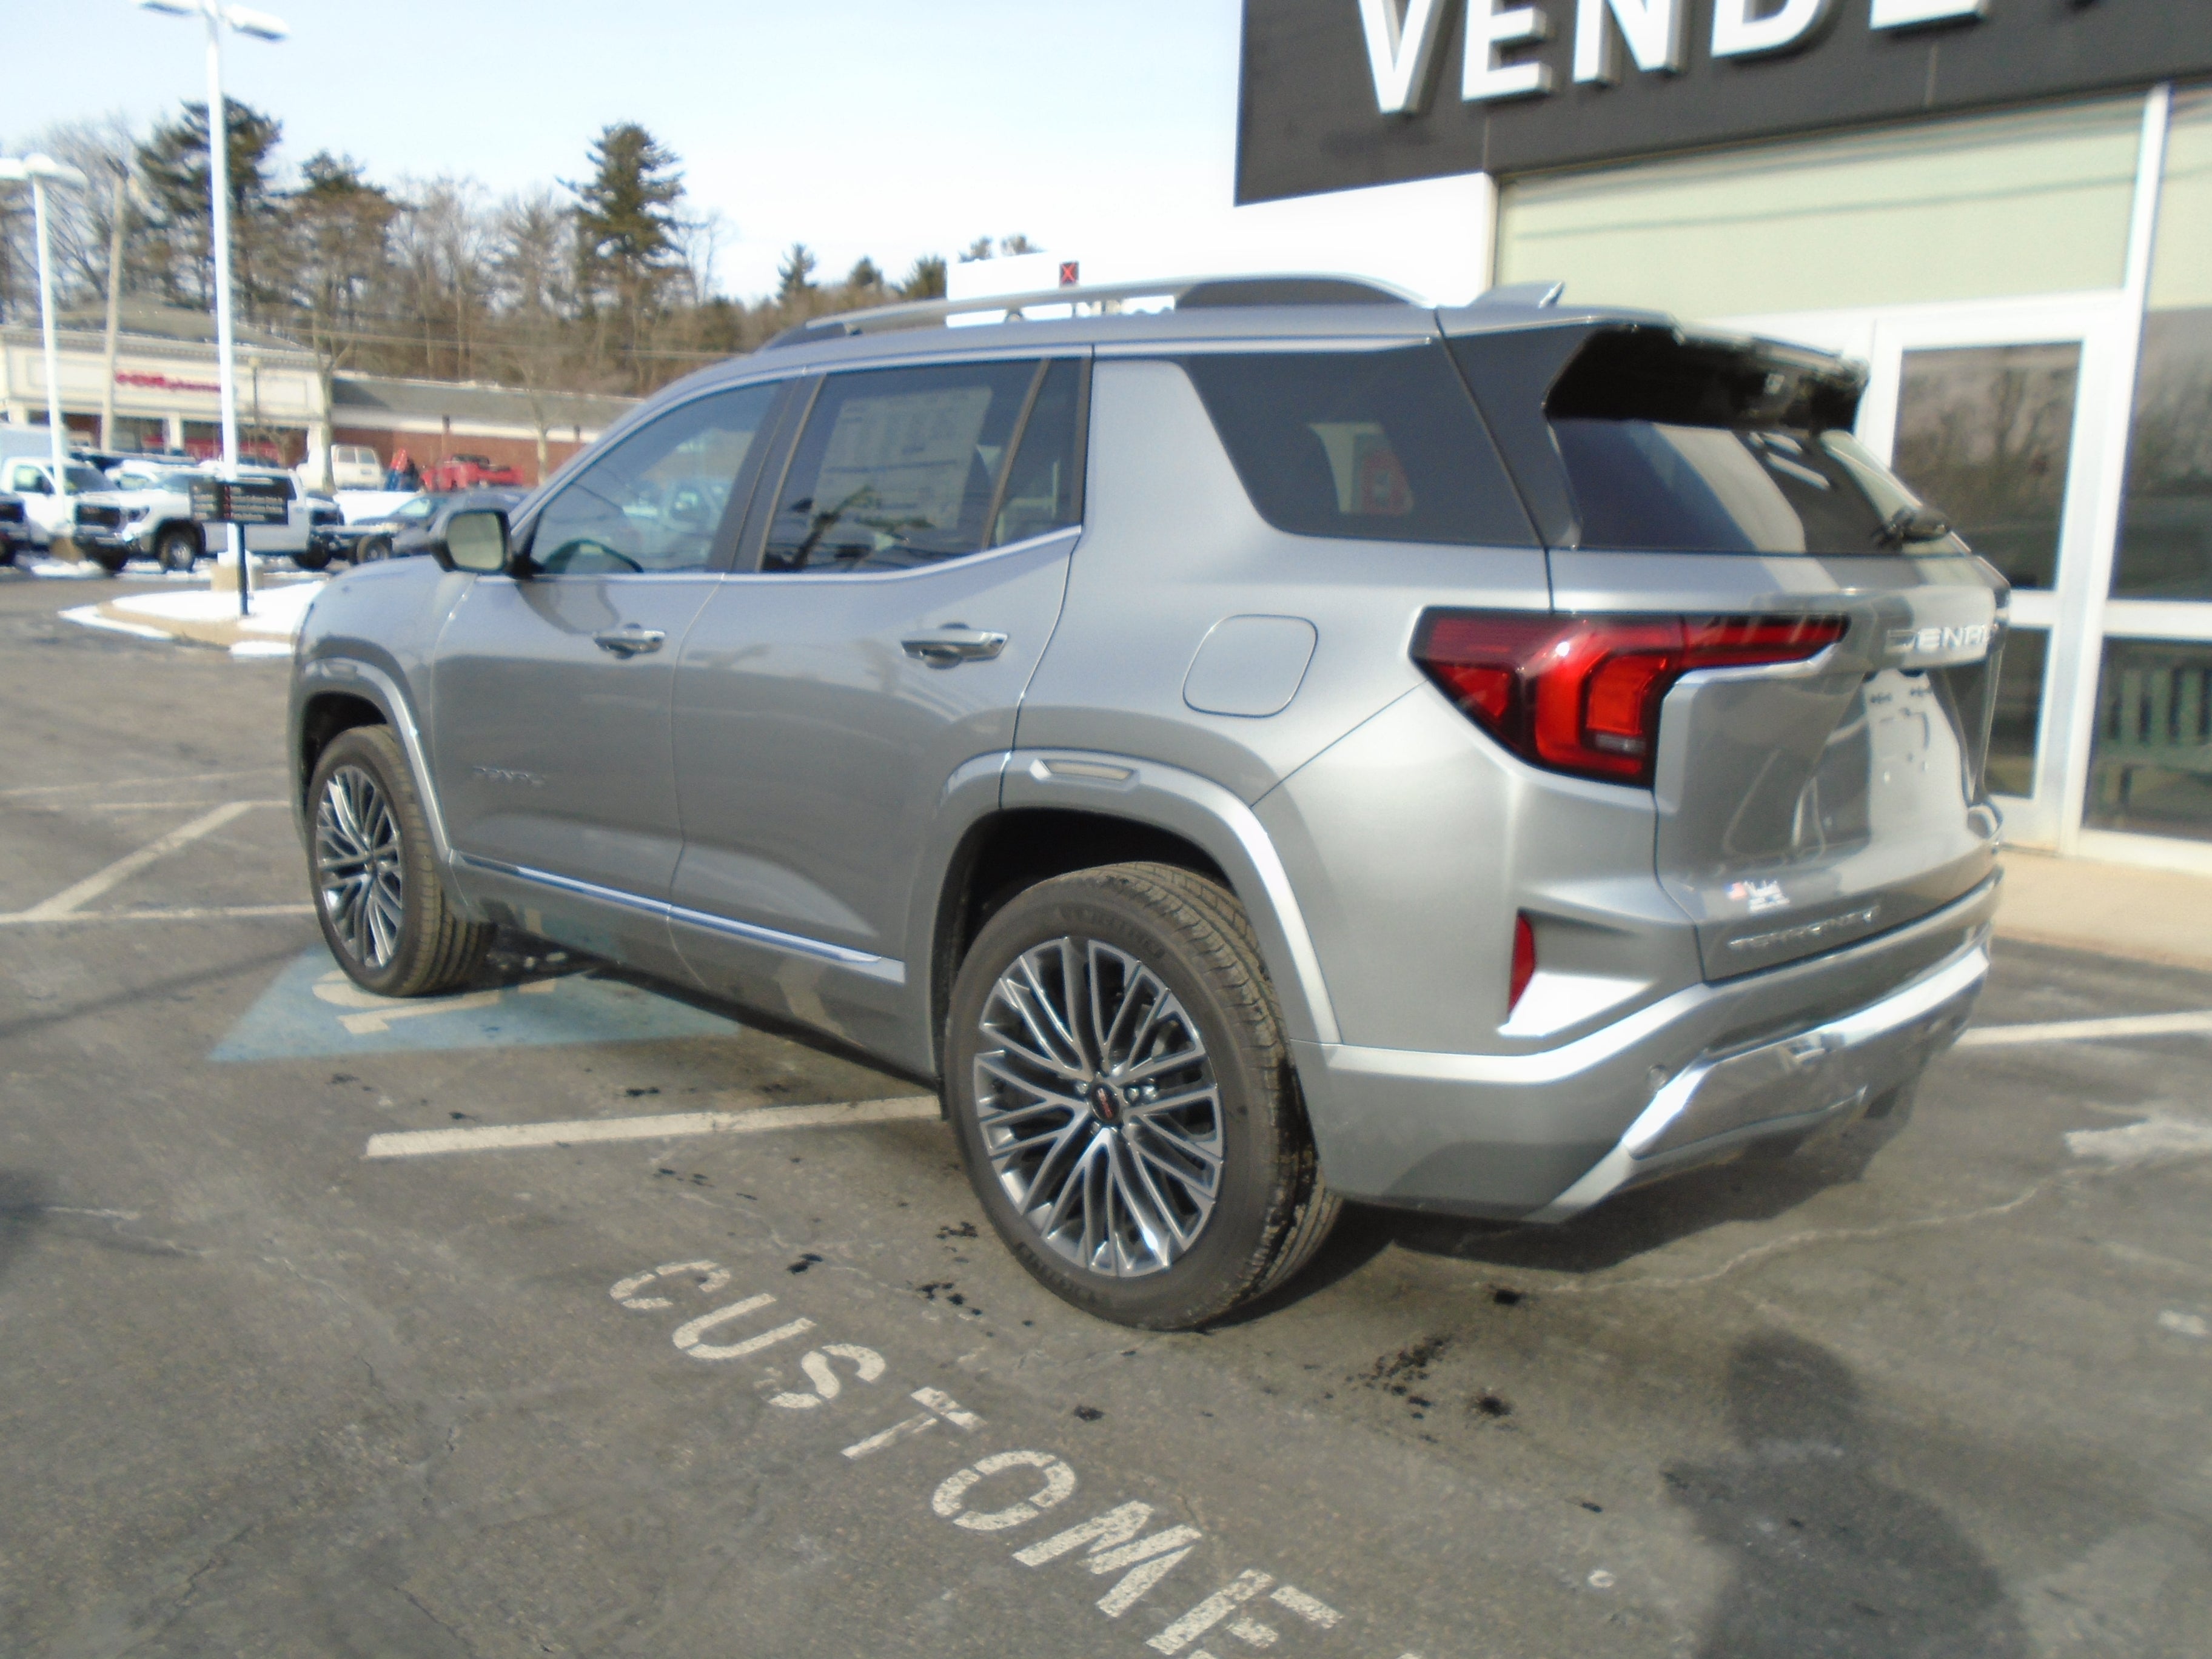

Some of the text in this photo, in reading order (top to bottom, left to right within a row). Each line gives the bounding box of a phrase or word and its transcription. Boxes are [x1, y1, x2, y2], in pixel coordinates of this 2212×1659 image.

[1357, 0, 1986, 115] VEN
[1883, 623, 2000, 654] DENA
[609, 1259, 1423, 1659] CUSTOME
